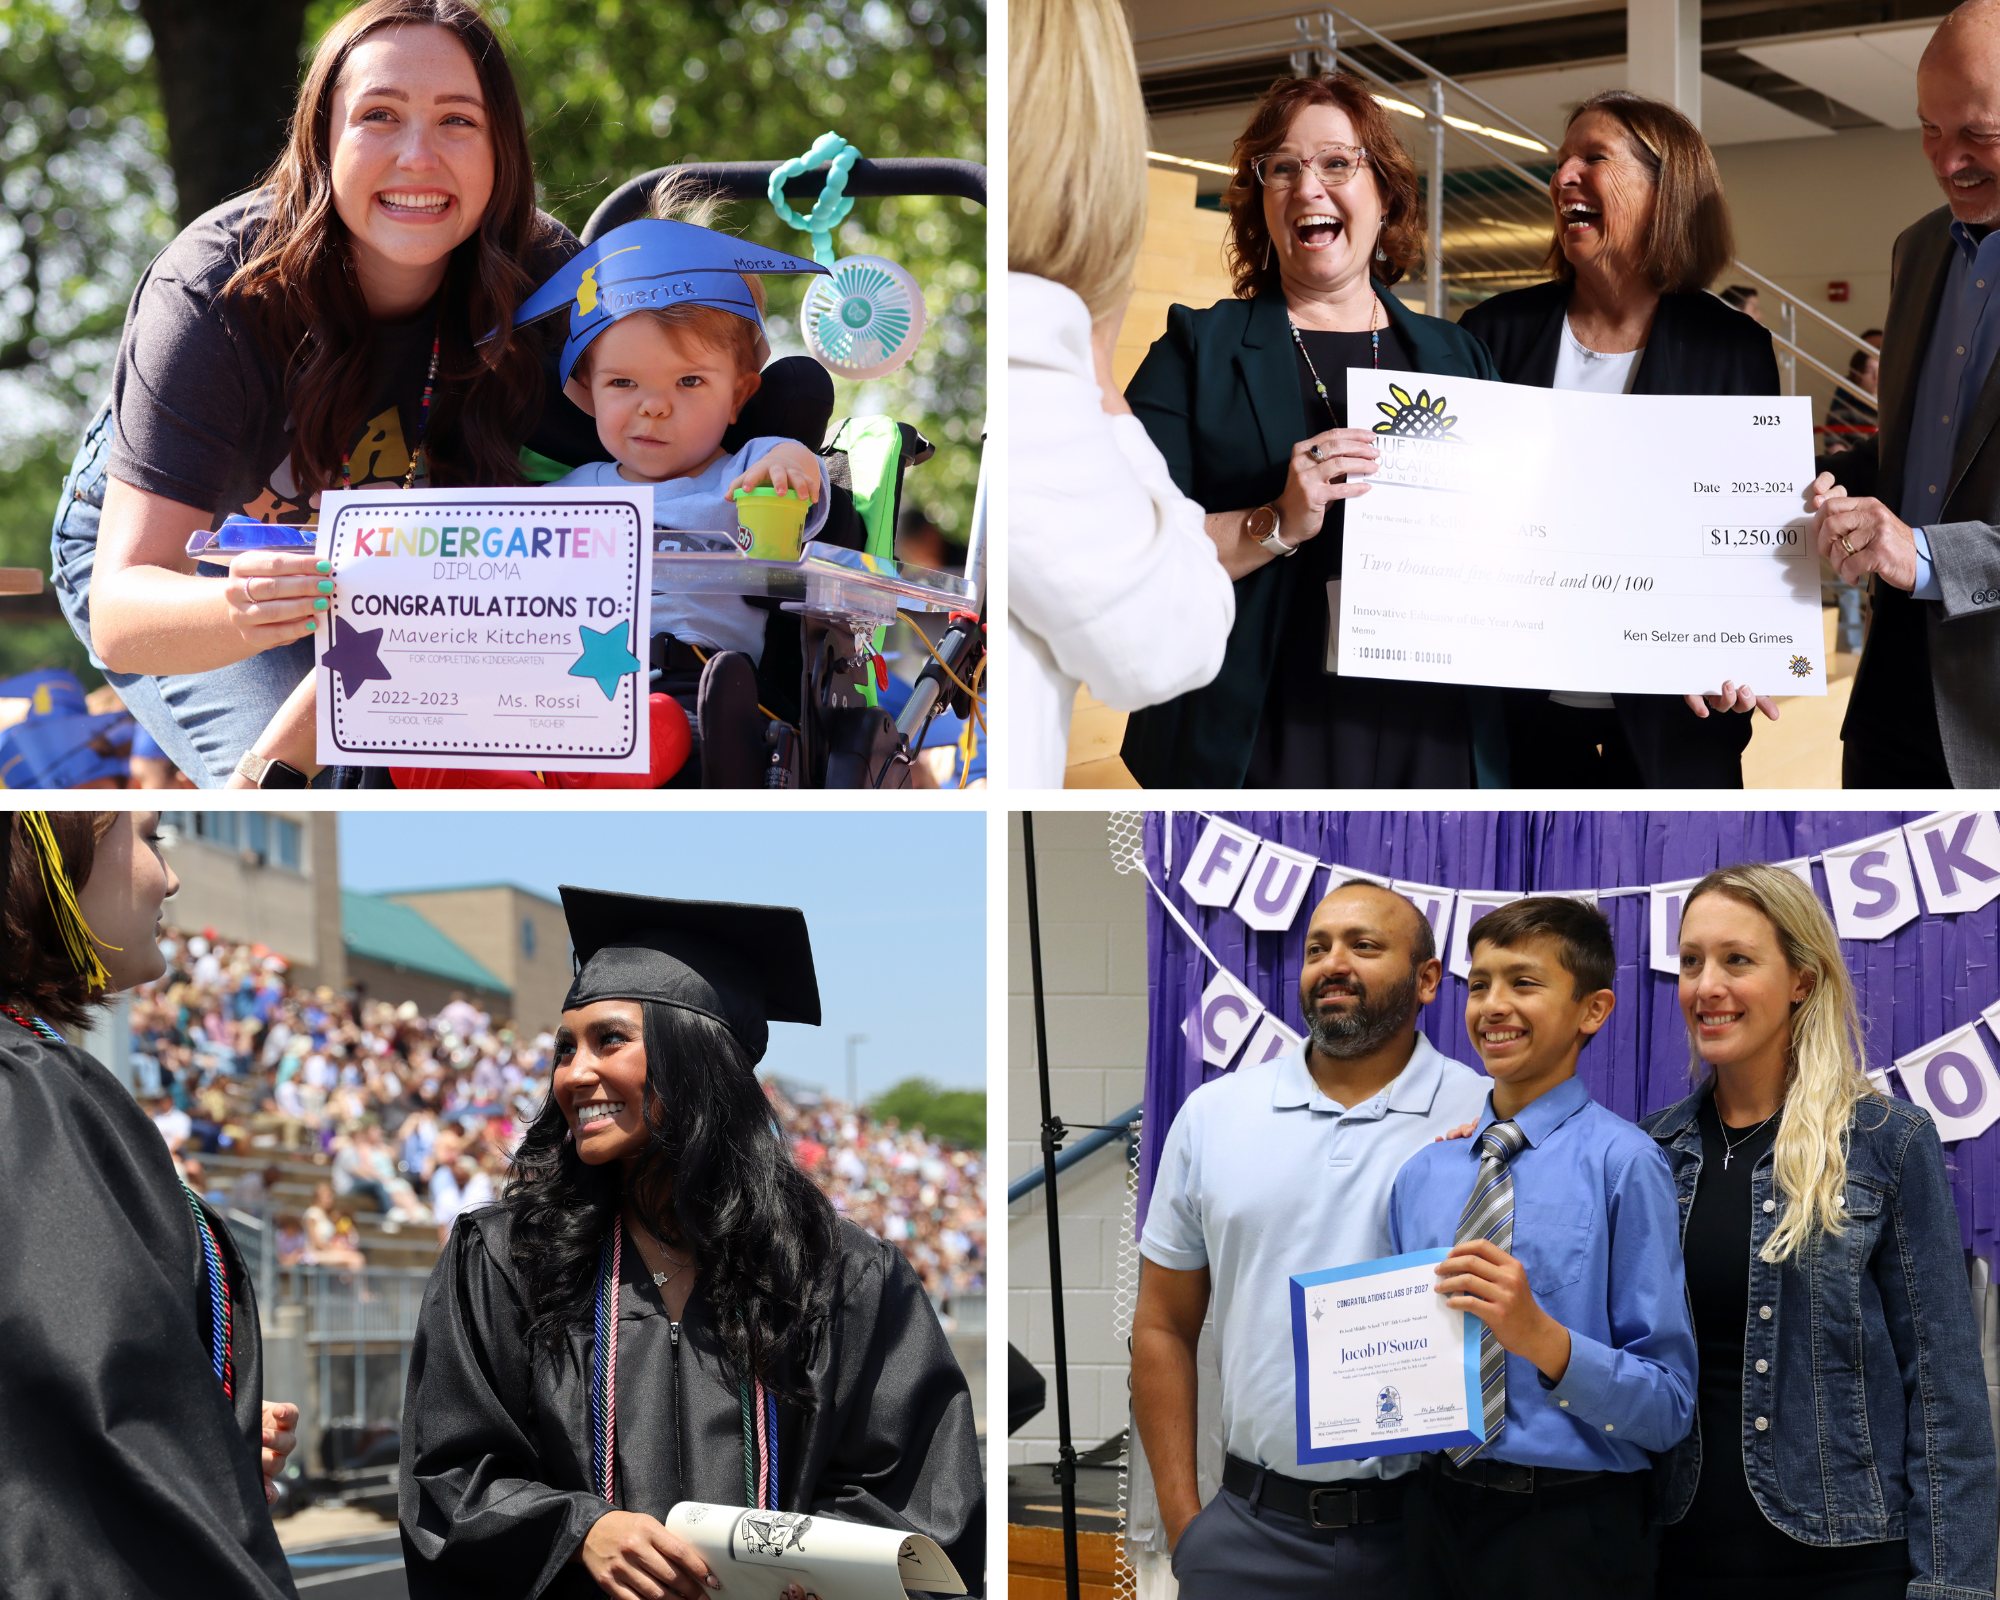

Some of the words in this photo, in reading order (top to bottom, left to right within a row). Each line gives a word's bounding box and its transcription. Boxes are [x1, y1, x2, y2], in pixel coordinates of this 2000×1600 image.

[734, 257, 775, 271] Morse
[782, 260, 797, 270] 23
[600, 279, 697, 318] Maverick
[1752, 415, 1781, 427] 2023
[1370, 436, 1406, 453] LUE
[1375, 455, 1470, 478] DUCATIONA
[1374, 471, 1473, 490] OUNDATION
[1693, 482, 1720, 493] Date
[1731, 482, 1794, 493] 2023-2024
[1361, 512, 1374, 522] Pay
[353, 526, 617, 559] KINDERGARTEN
[1710, 528, 1797, 548] $1,250.00
[433, 562, 522, 580] DIPLOMA
[1359, 552, 1392, 572] Two
[1397, 557, 1464, 578] thousand
[1497, 569, 1556, 587] hundred
[1559, 574, 1588, 590] and
[1591, 574, 1654, 593] 00/100
[351, 594, 578, 617] CONGRATULATIONS
[1353, 605, 1407, 620] Innovative
[1409, 609, 1454, 624] Educator
[1456, 613, 1469, 624] of
[1469, 615, 1485, 626] the
[1487, 616, 1510, 628] Year
[1512, 618, 1544, 631] Award
[389, 628, 477, 645] Maverick
[487, 629, 572, 645] Kitchens
[1351, 626, 1376, 635] Memo
[1623, 629, 1648, 642] Ken
[1651, 630, 1690, 643] Selzer
[1693, 631, 1716, 643] and
[1720, 632, 1746, 644] Deb
[1749, 632, 1794, 644] Grimes
[409, 654, 425, 664] FOR
[427, 654, 480, 665] COMPLETING
[482, 655, 544, 665] KINDERGARTEN
[371, 690, 459, 706] 2022-2023
[498, 694, 528, 708] Ms.
[535, 694, 581, 709] Rossi
[388, 715, 420, 725] SCHOOL
[423, 716, 443, 726] YEAR
[529, 719, 565, 729] TEACHER
[1336, 1292, 1386, 1309] CONGRATULATIONS
[1387, 1288, 1405, 1299] CLASS
[1405, 1287, 1413, 1296] OF
[1414, 1284, 1429, 1294] 2027
[1341, 1343, 1375, 1365] Jacob
[1377, 1337, 1428, 1356] D'Souza
[1377, 1421, 1402, 1429] KNIGHTS
